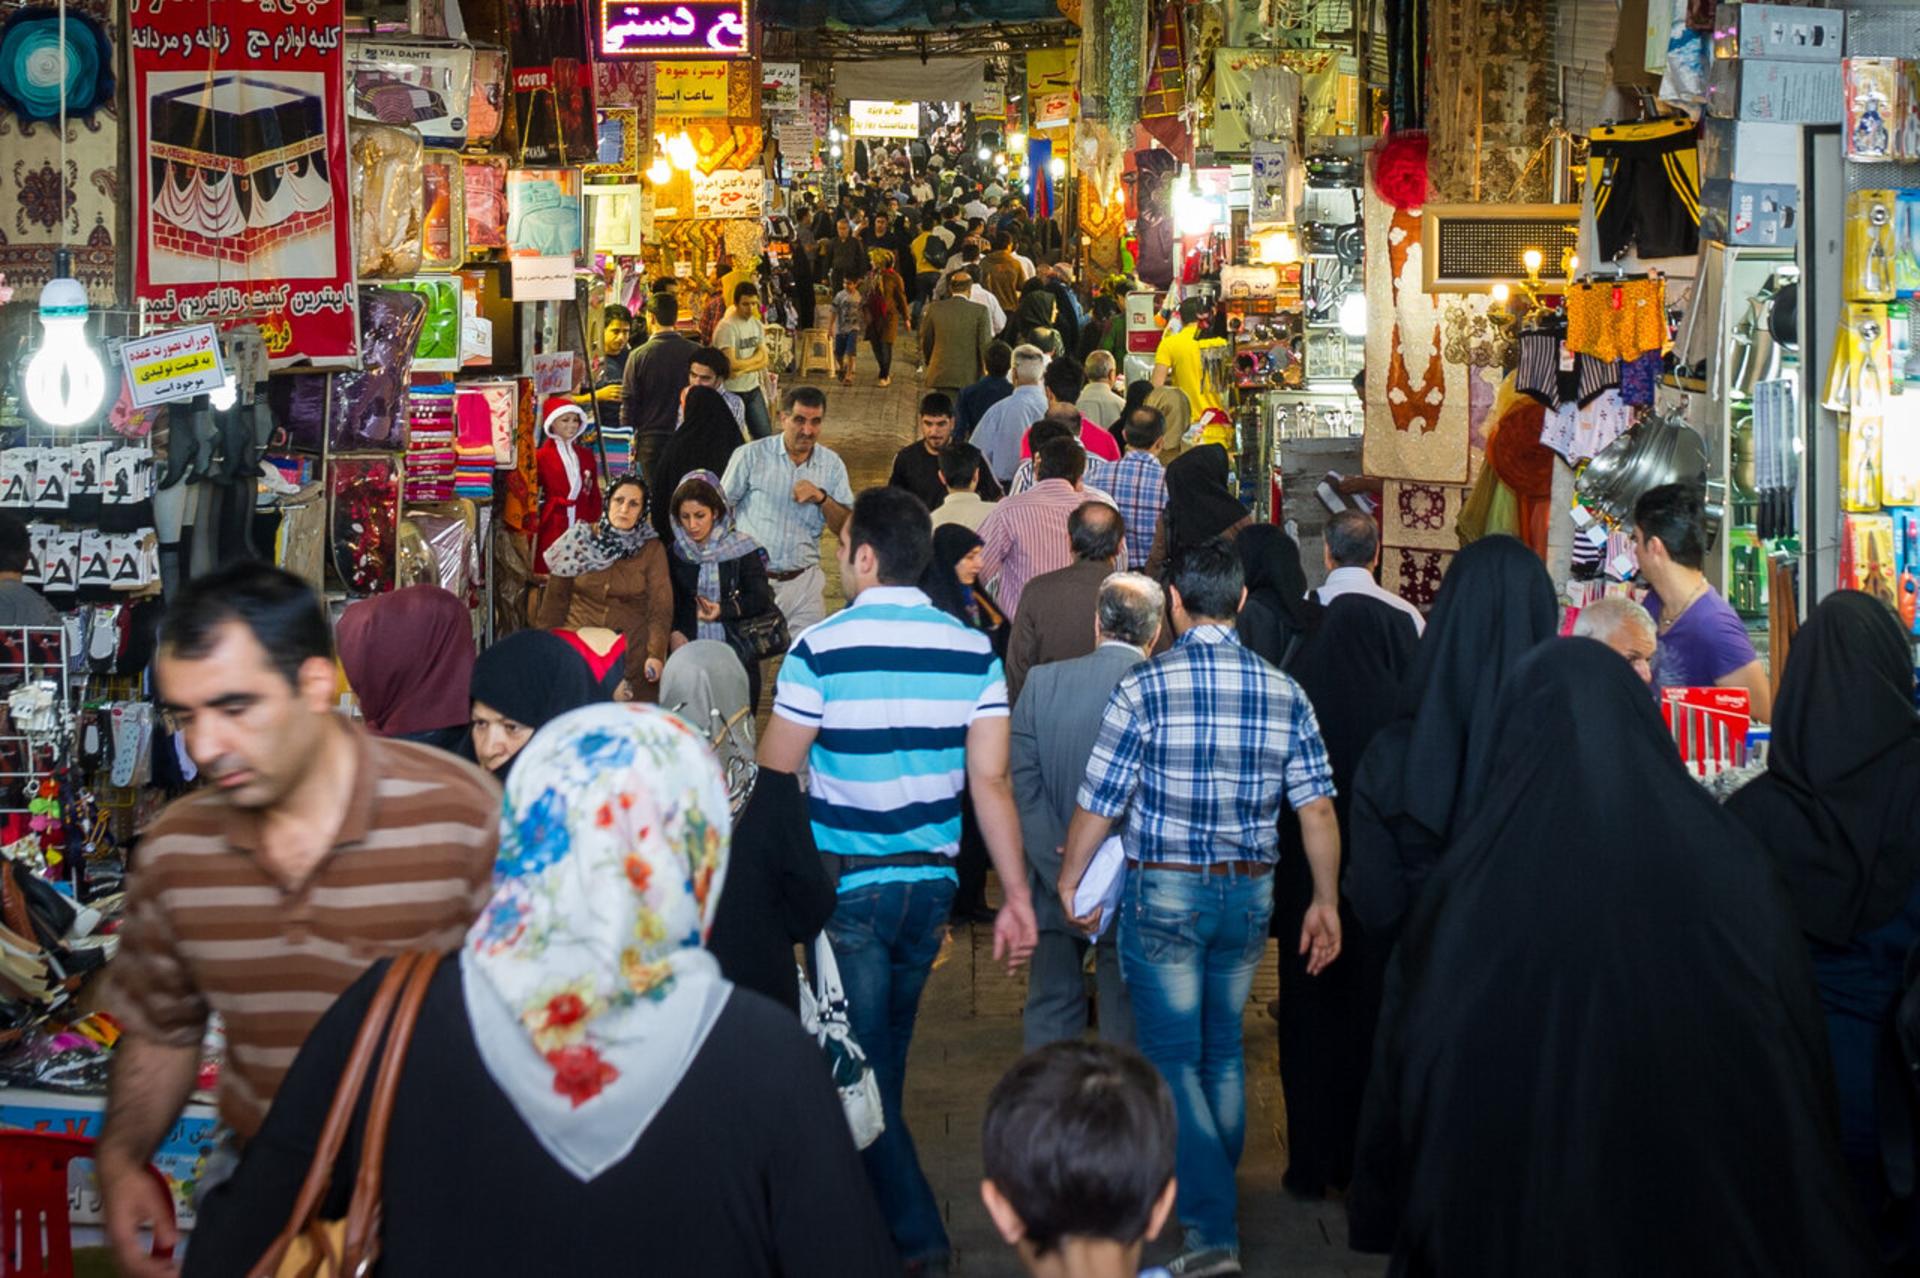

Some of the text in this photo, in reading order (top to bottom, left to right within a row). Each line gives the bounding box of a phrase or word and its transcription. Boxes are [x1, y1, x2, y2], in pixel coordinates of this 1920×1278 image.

[605, 6, 743, 51] ع دستی
[131, 25, 341, 60] کلیه لوازم حج زنانه و مردانه
[379, 49, 396, 58] VIA
[398, 51, 432, 59] DANTE
[518, 73, 548, 87] COVER
[683, 89, 714, 100] ساعت
[719, 191, 743, 207] حج
[292, 287, 344, 315] بهترین
[344, 282, 354, 307] ا
[183, 335, 211, 352] جوراب
[129, 347, 151, 361] عمده
[140, 356, 211, 382] به قیمت تولیدی
[154, 379, 204, 395] موجود است
